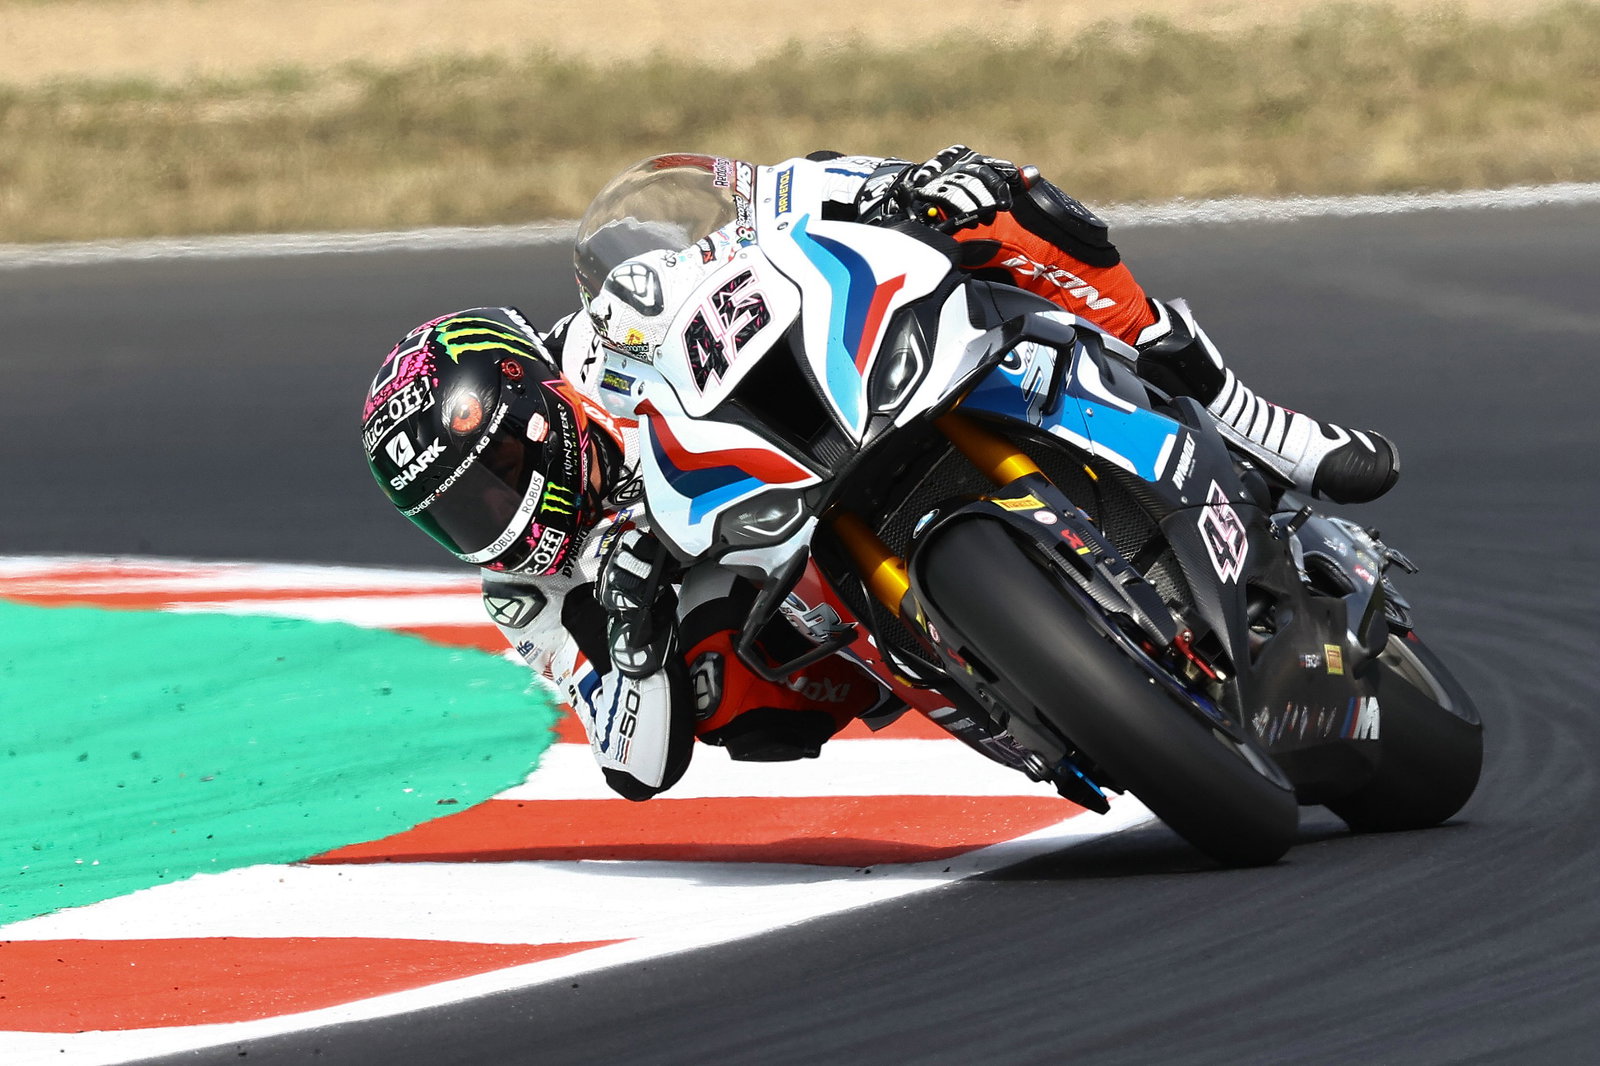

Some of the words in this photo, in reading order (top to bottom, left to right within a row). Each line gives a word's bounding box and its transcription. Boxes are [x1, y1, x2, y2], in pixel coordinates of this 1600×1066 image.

[778, 169, 791, 213] RAVENOL
[682, 267, 773, 394] 45
[390, 437, 448, 491] SHARK
[475, 435, 491, 454] AG
[487, 528, 517, 556] ROBUS
[521, 475, 543, 515] ROBUS
[1199, 479, 1249, 584] 45
[619, 690, 640, 739] 50
